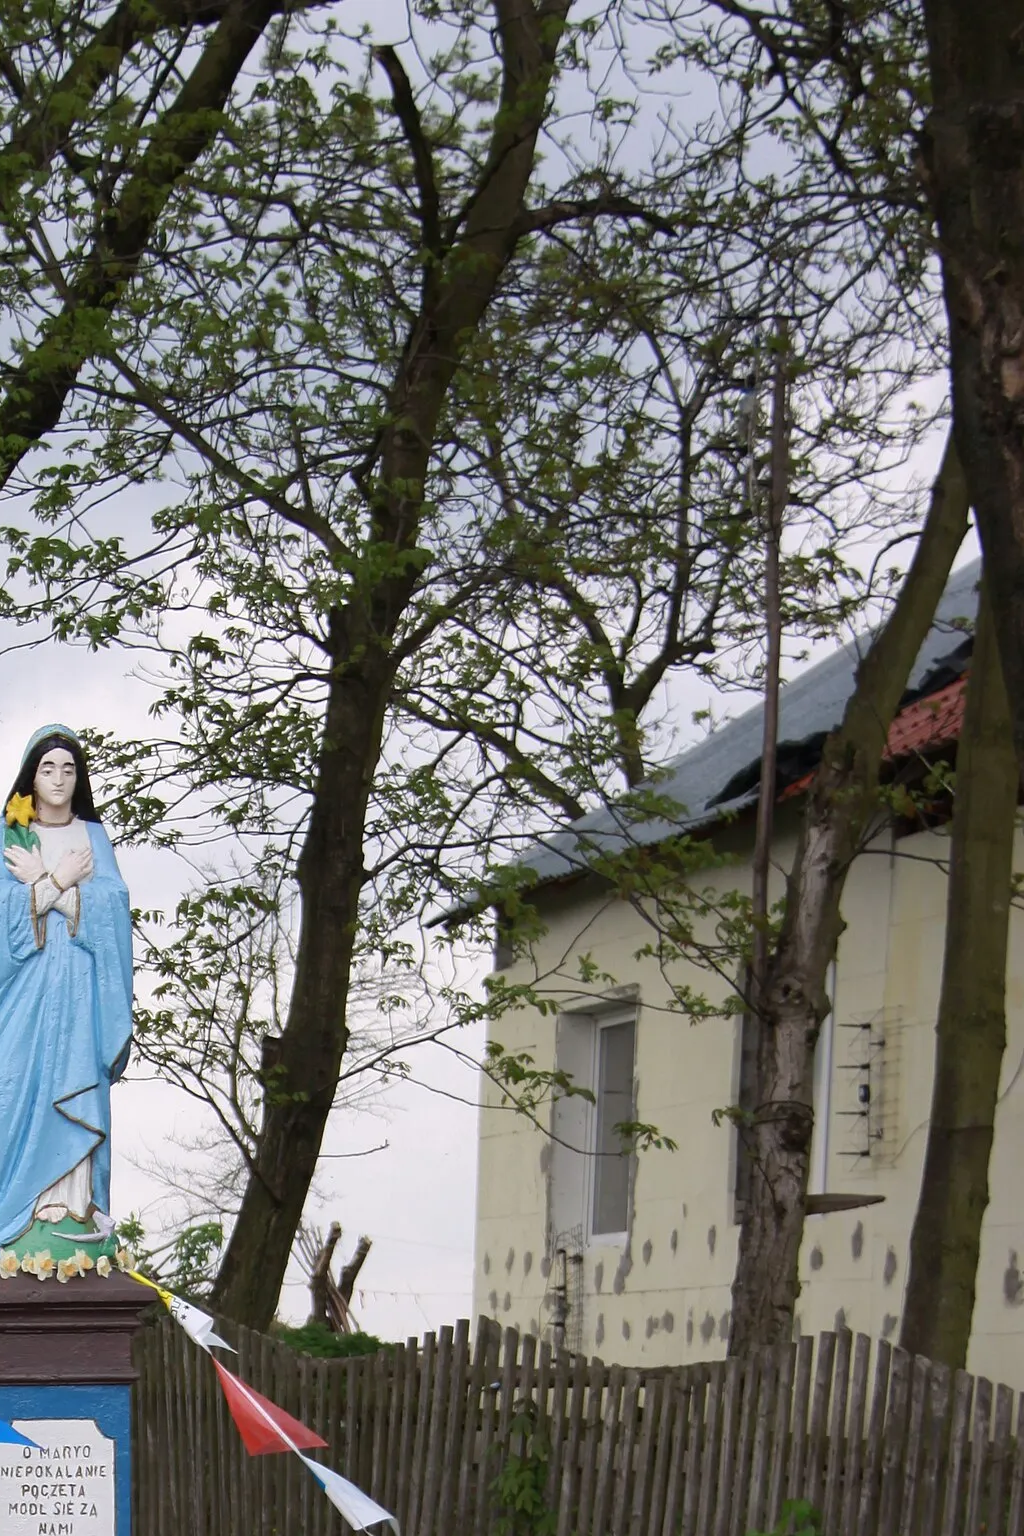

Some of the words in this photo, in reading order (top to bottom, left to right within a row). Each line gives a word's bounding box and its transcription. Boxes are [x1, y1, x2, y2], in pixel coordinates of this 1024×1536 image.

[23, 1446, 32, 1459] O
[0, 1465, 107, 1479] NIEPOKALANIE
[80, 1503, 98, 1518] ZA
[38, 1522, 73, 1536] NAMI
